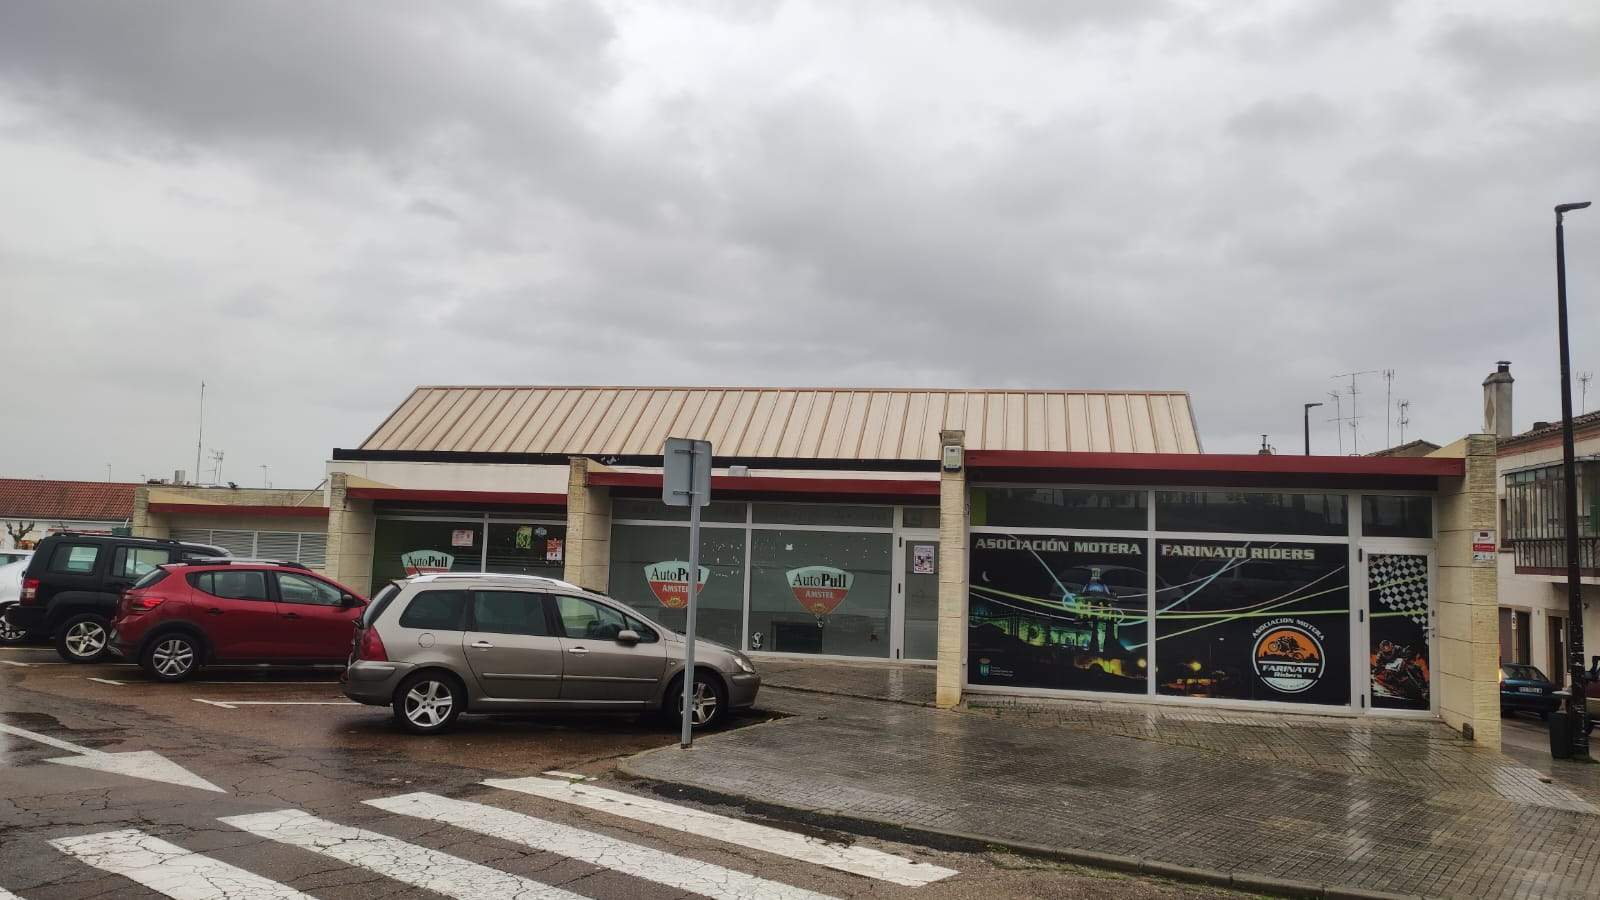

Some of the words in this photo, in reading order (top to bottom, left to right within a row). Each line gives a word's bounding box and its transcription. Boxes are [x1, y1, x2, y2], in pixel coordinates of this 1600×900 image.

[976, 538, 1069, 552] ASOCIACIÓN
[1074, 541, 1142, 555] MOTERA
[1161, 544, 1247, 558] FARINATO
[1251, 548, 1315, 560] RIDERS
[407, 555, 448, 567] AutoPull
[651, 567, 702, 582] AutoPl
[792, 572, 846, 588] AutoPull
[806, 590, 834, 599] AMSTEL
[1296, 619, 1325, 640] MOTERA
[1262, 665, 1316, 674] FARINATO
